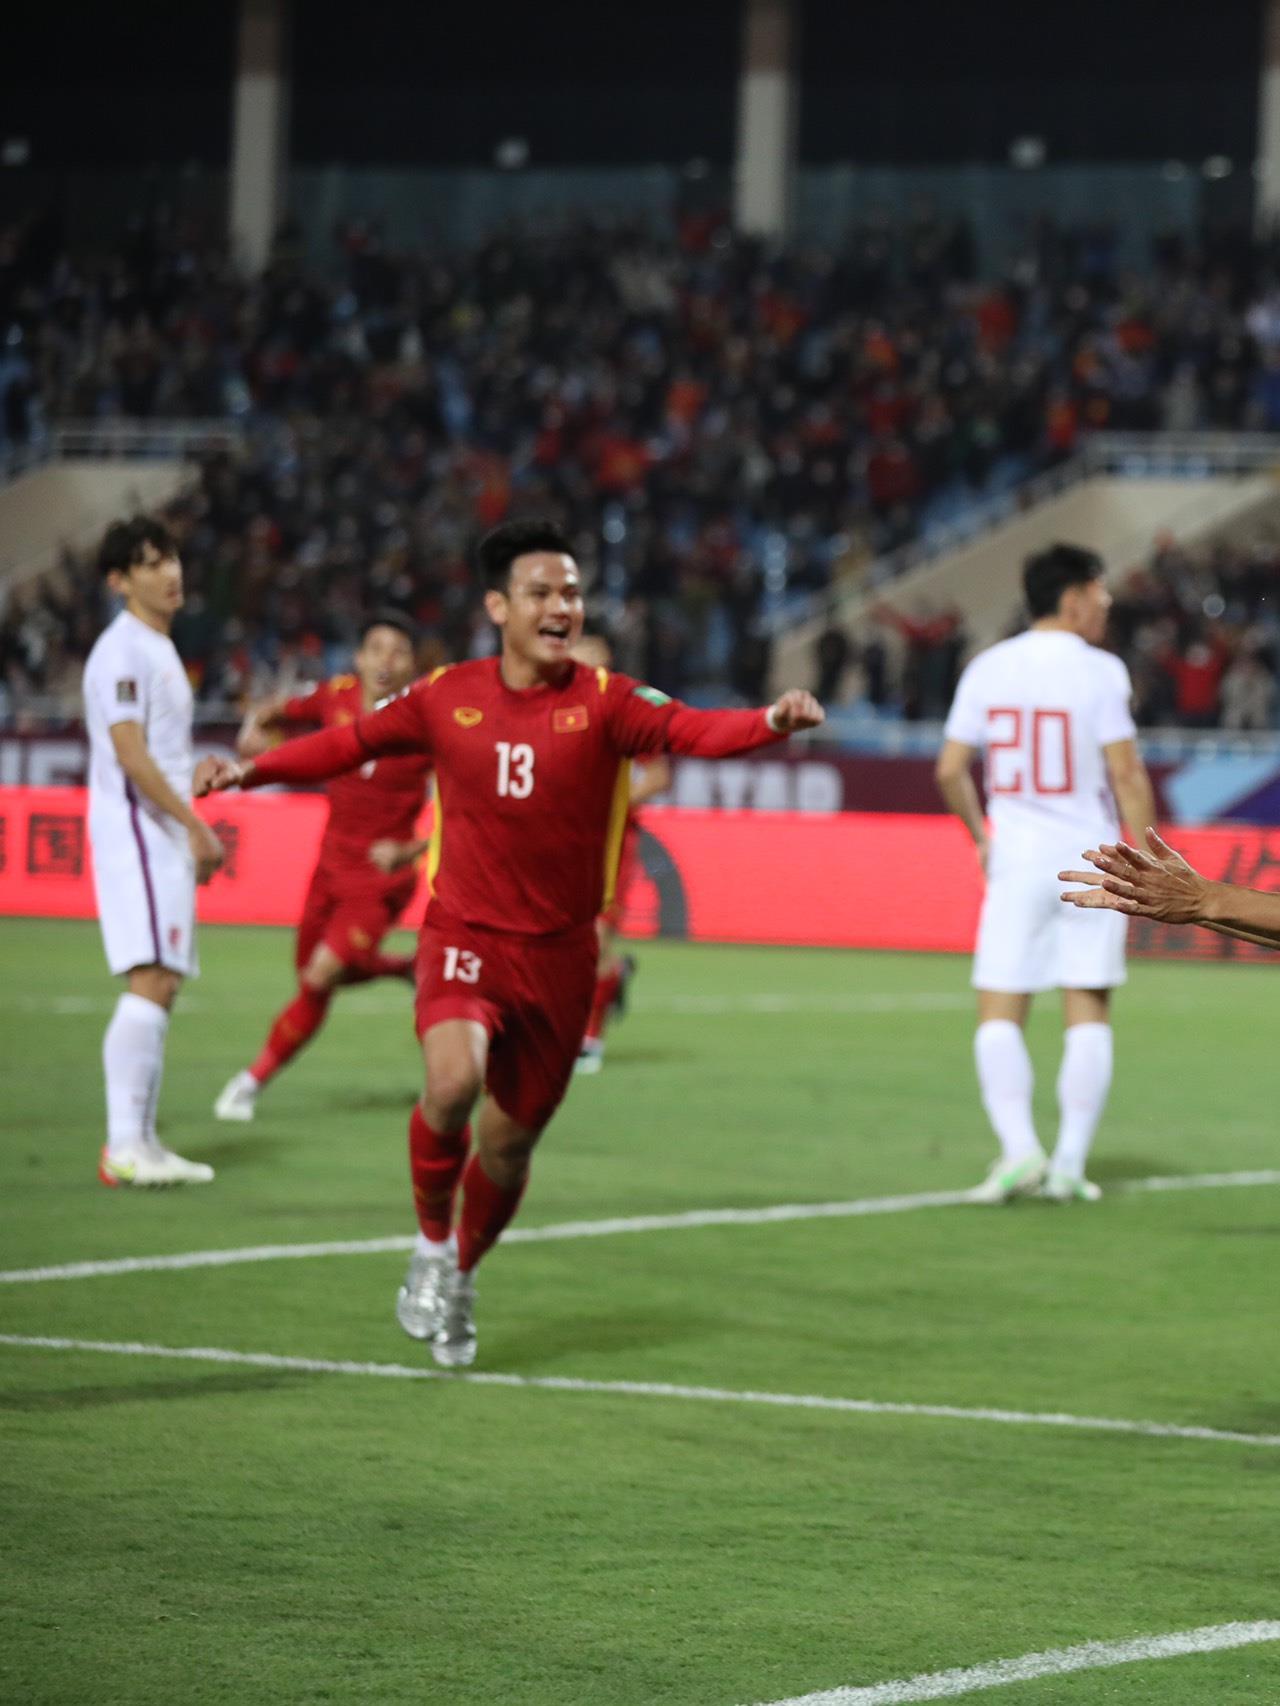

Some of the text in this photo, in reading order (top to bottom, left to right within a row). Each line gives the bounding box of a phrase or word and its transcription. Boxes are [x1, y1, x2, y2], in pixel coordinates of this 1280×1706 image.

[495, 741, 535, 799] 13
[986, 707, 1074, 793] 20
[443, 947, 482, 983] 13
